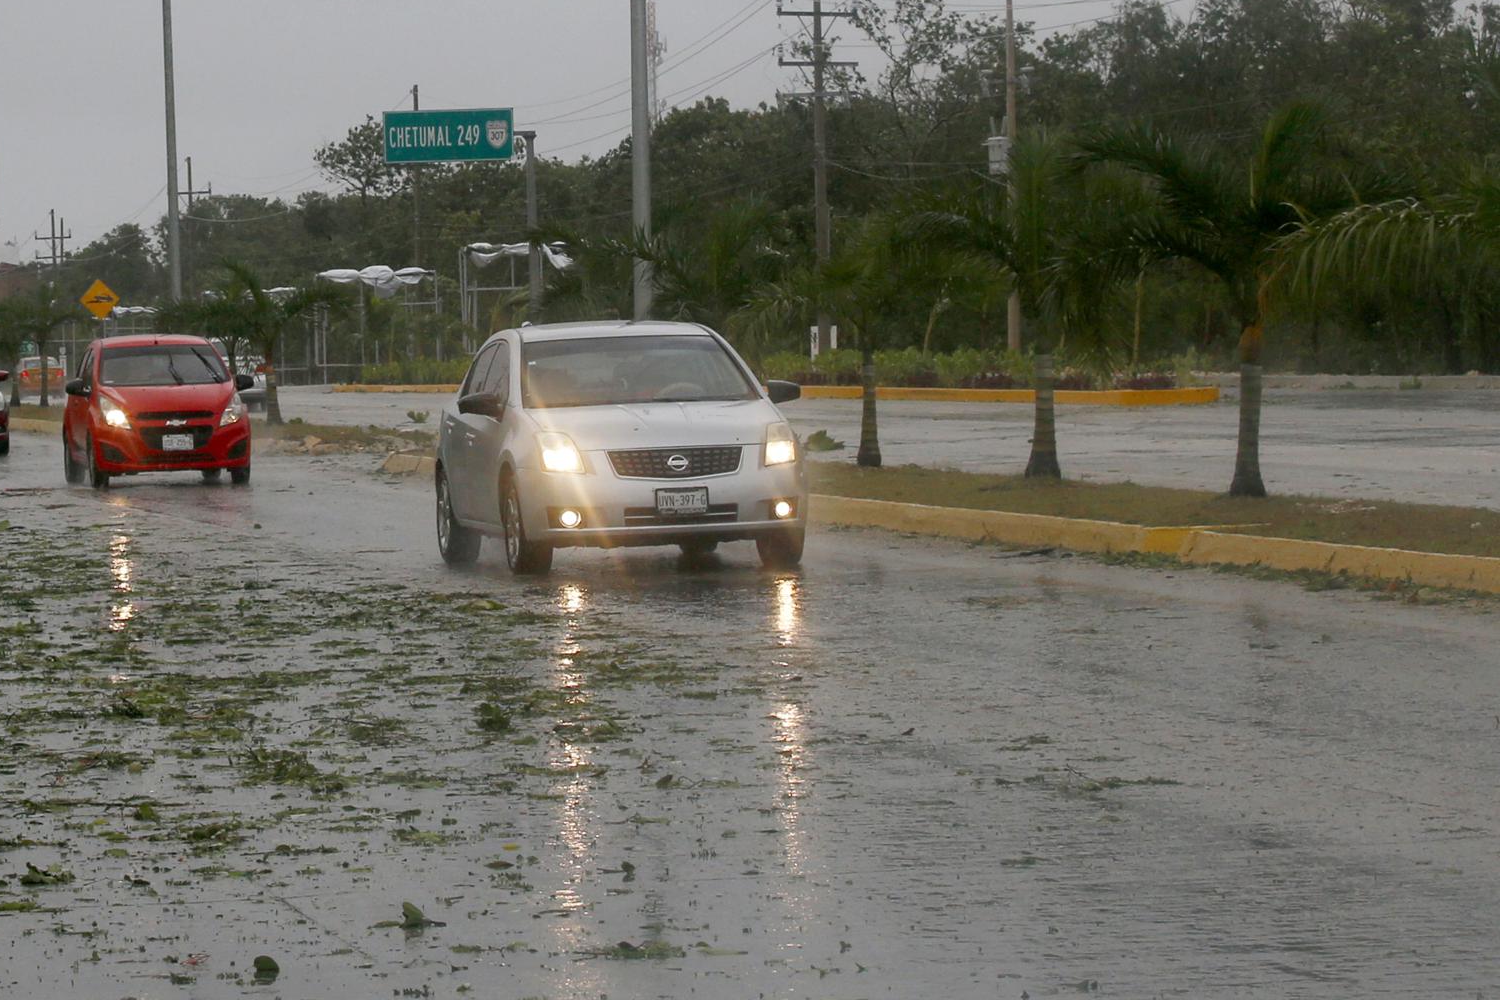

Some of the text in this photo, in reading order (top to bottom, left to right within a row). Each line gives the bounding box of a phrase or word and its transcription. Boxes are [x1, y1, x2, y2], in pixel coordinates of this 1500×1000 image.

[389, 124, 480, 148] CHETUMAL 249
[490, 130, 504, 141] 307
